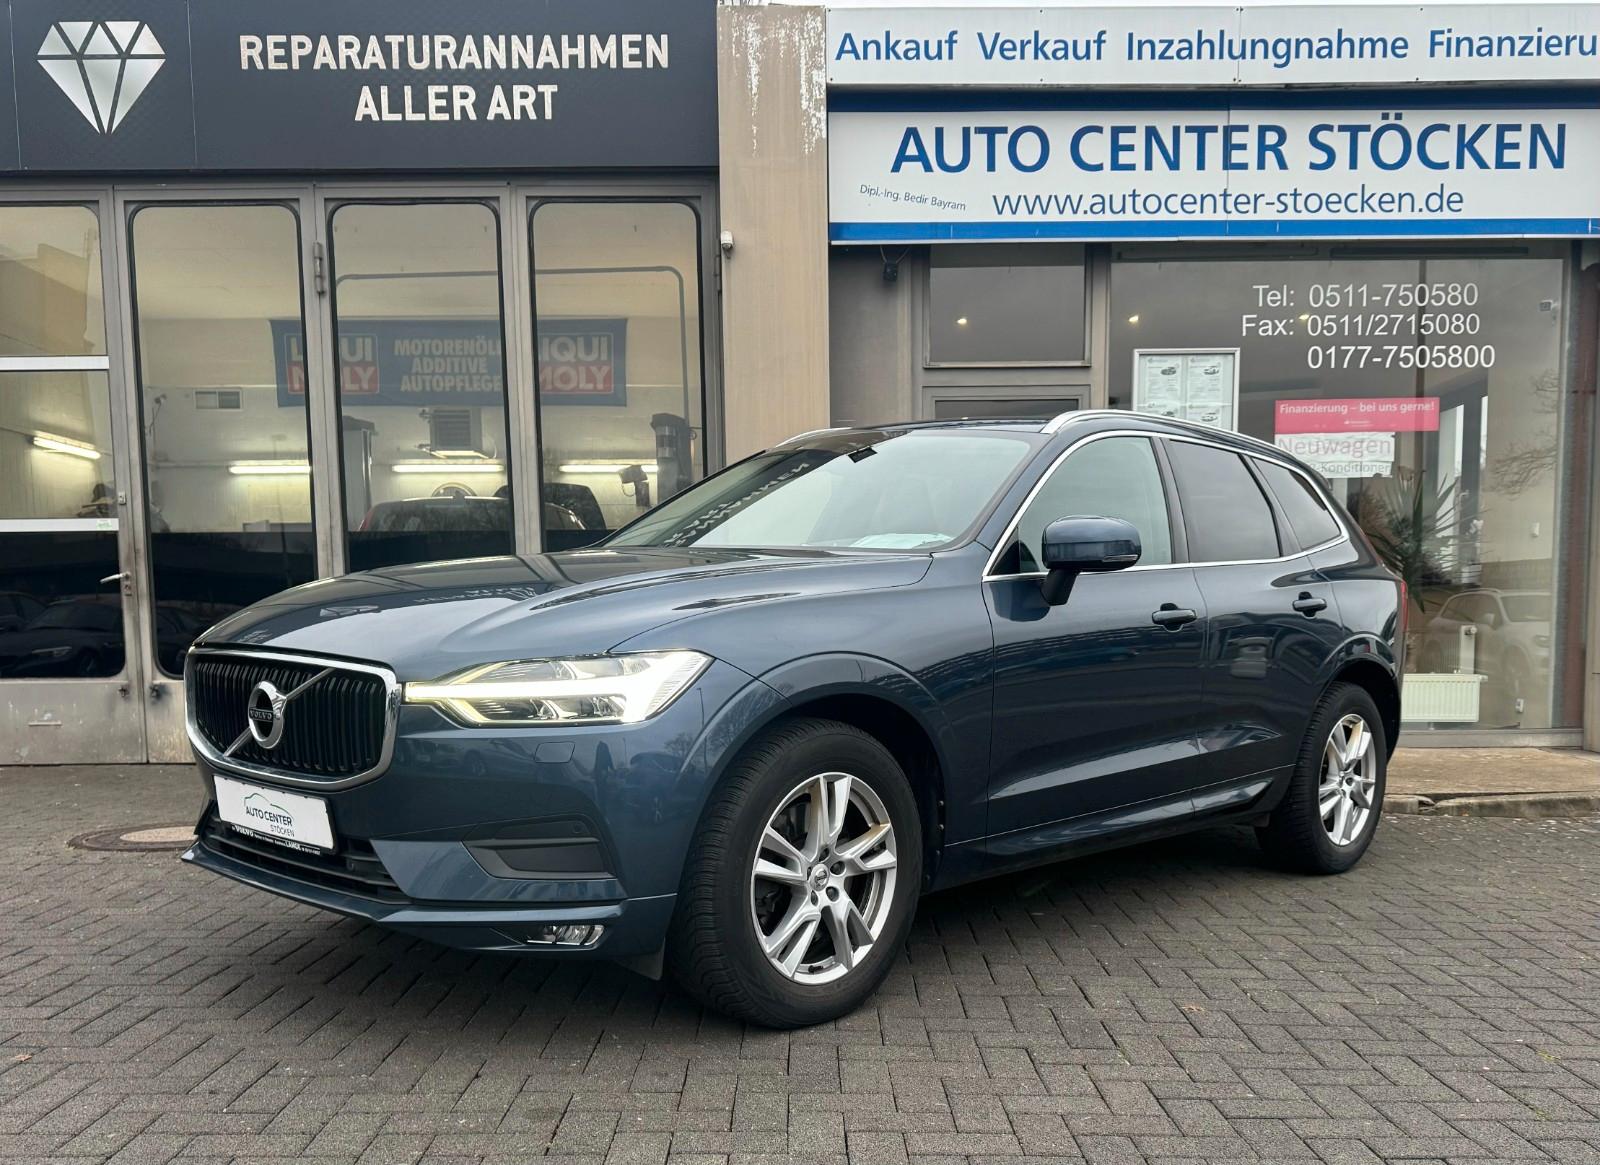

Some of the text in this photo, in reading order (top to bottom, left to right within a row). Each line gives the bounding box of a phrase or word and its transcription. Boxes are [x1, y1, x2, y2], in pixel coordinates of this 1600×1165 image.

[240, 34, 669, 70] REPARATURANNAHMEN
[835, 27, 1598, 68] Ankauf Verkauf Inzahlungnahme Finanzieru
[355, 85, 558, 122] ALLER ART
[890, 112, 1567, 174] AUTO CENTER STÖCKEN
[859, 184, 967, 212] Dipl.-Ing. Bedir Bayram
[992, 182, 1465, 215] www.autocenter-stoecken.de
[1252, 283, 1479, 308] Tel: 0511-750580
[1242, 313, 1481, 337] Fax: 0511/2715080
[538, 335, 608, 362] IQUI
[1307, 344, 1496, 369] 0177-7505800
[411, 357, 488, 374] ADDITIVE
[400, 375, 502, 393] AUTOPFLEGE
[1279, 402, 1348, 415] Finanzierung
[1359, 401, 1376, 413] bei
[1378, 403, 1398, 412] uns
[1400, 401, 1436, 414] gerne!
[1278, 437, 1392, 459] Neuwagen
[249, 709, 273, 720] VOLVO
[246, 806, 293, 828] AUTO CENTER
[270, 824, 295, 838] STÖCKEN
